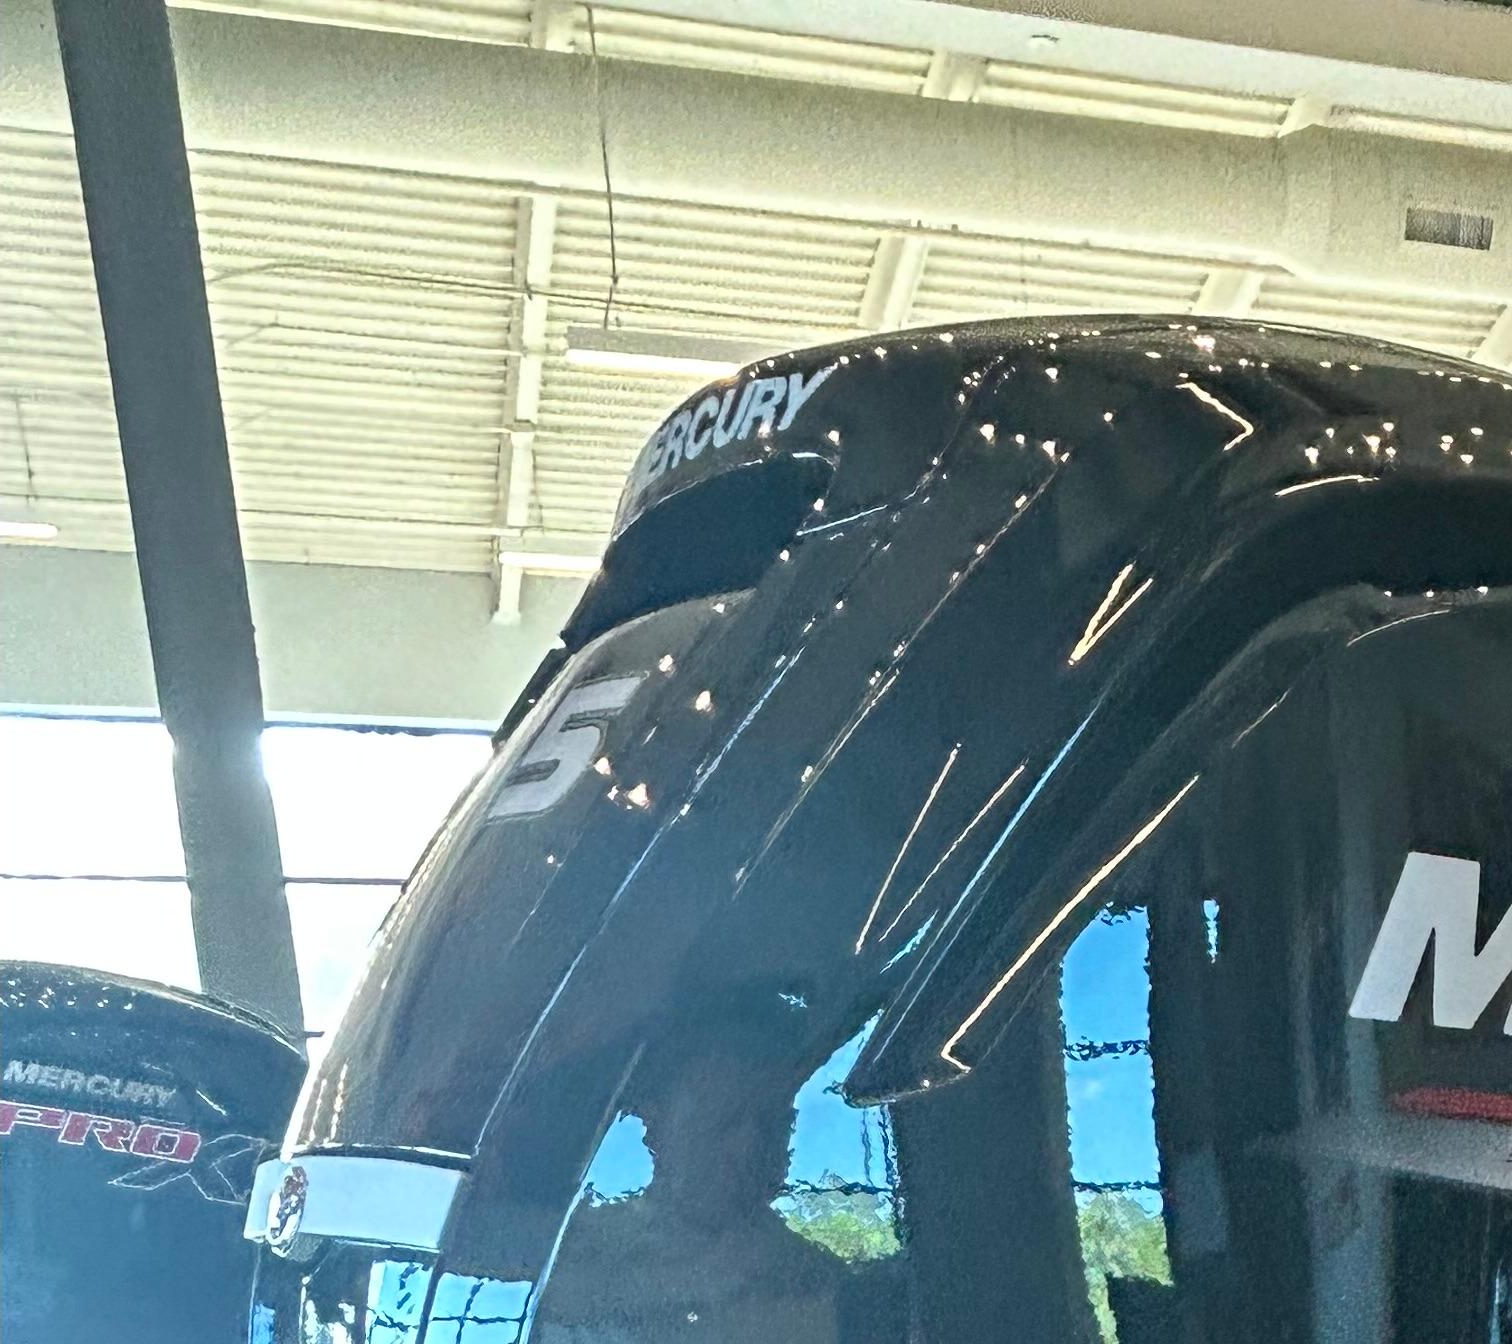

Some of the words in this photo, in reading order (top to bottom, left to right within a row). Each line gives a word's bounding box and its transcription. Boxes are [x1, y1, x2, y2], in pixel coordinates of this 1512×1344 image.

[628, 363, 838, 488] ERCURY
[3, 1059, 177, 1108] MERCURY
[0, 1100, 201, 1163] PRO
